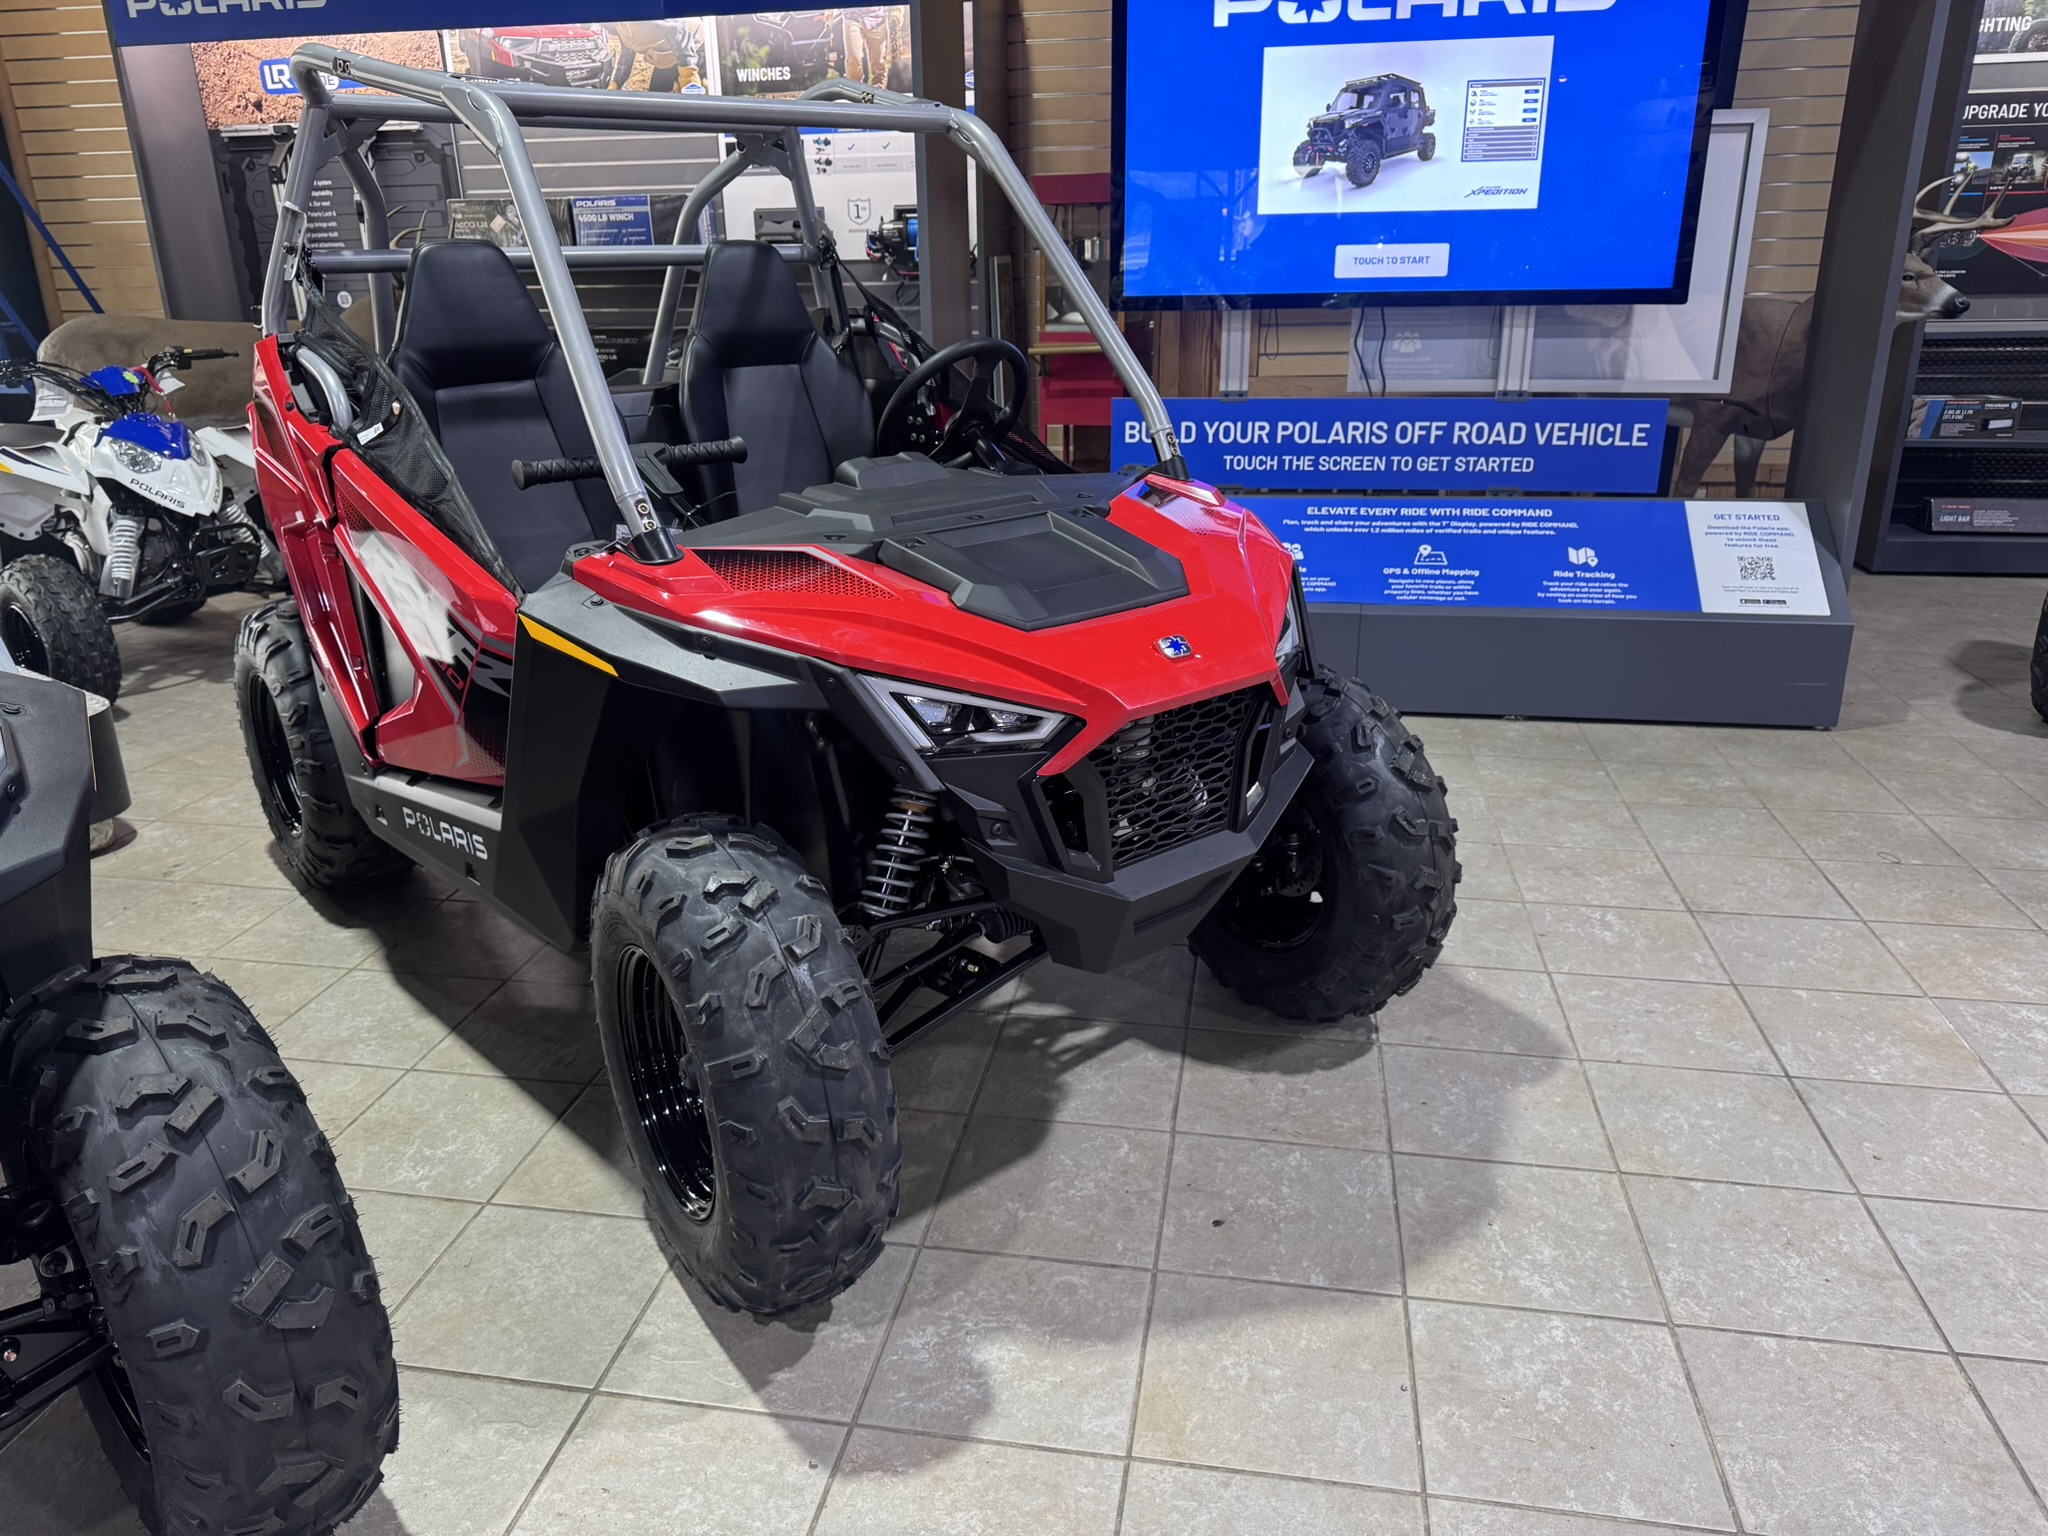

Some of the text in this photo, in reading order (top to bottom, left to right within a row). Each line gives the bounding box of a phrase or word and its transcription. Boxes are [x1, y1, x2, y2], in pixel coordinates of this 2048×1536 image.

[127, 0, 328, 18] POLA
[1979, 15, 2032, 33] GHTING
[736, 66, 791, 82] WINCHES
[2034, 102, 2048, 118] YO
[1464, 186, 1528, 199] XPEDITION
[608, 213, 634, 222] WINCH
[1353, 256, 1431, 265] TOUCH TO START
[1124, 421, 1651, 446] BUD YOUR POLARIS OFF ROAD VEHICLE
[1223, 455, 1534, 472] TOUCH THE SCREEN TO GET STARTED
[130, 478, 186, 509] POLARIS
[1307, 507, 1553, 517] ELEVATE EVERY RIDE WITH RIDE COMMAND
[1442, 568, 1479, 577] Mapping
[1575, 571, 1615, 579] Tracking
[402, 806, 488, 860] POLARIS
